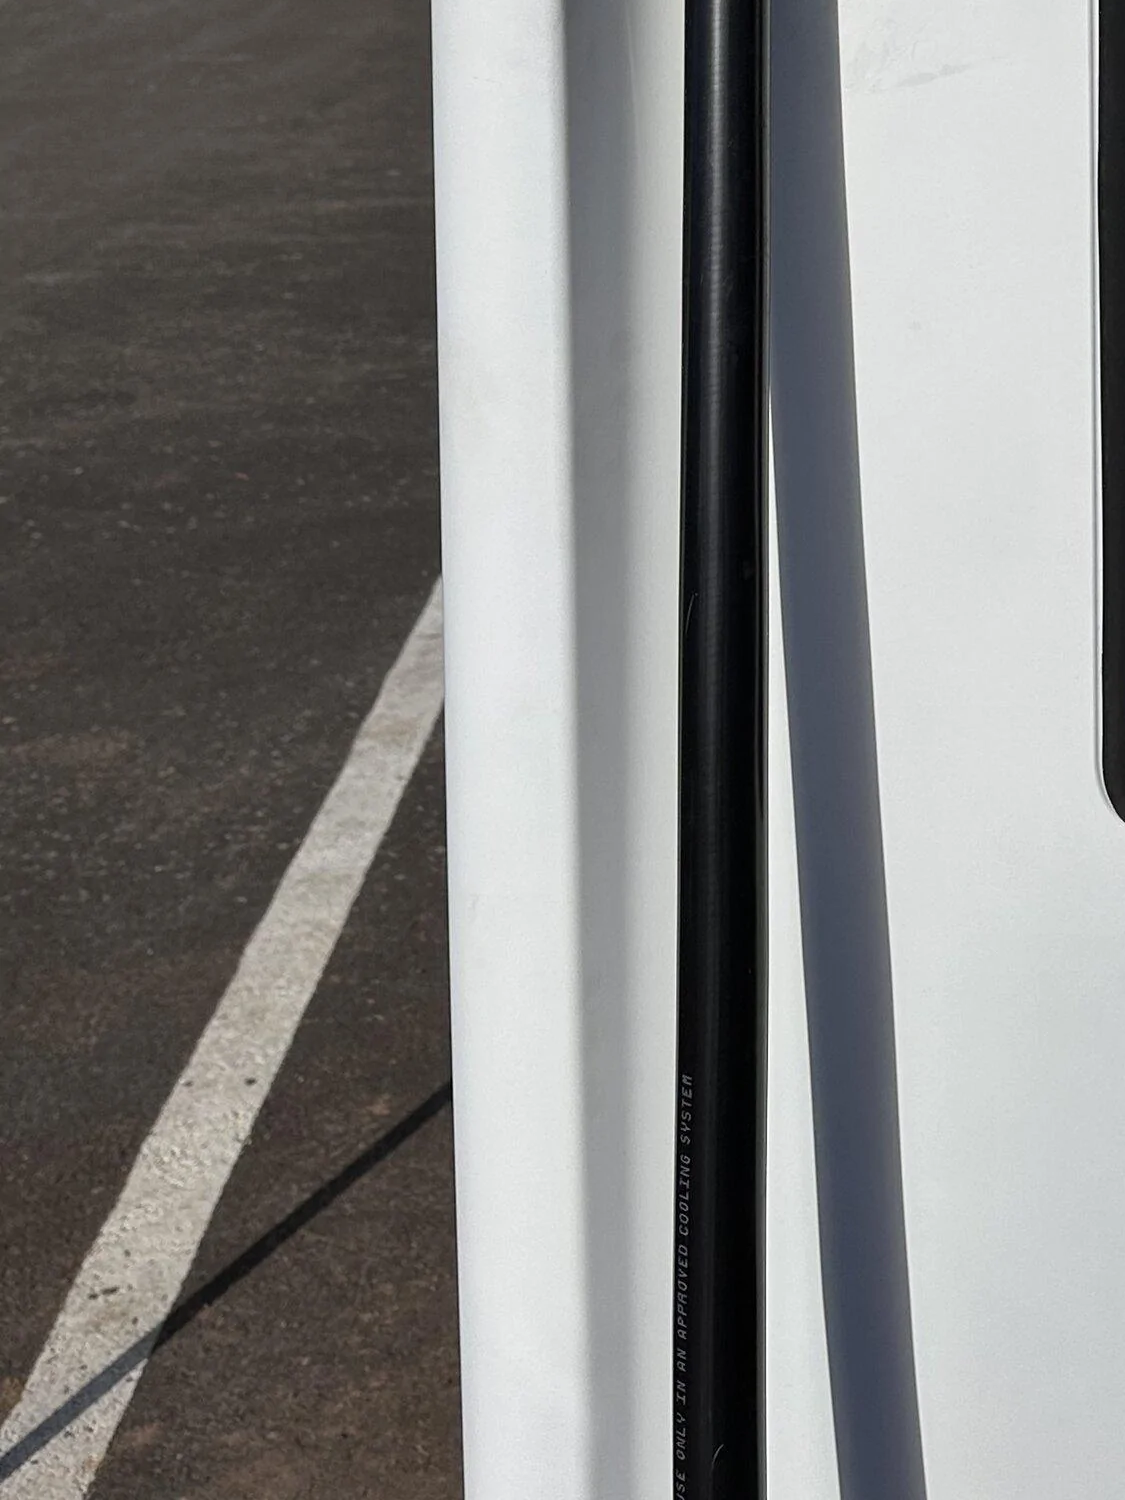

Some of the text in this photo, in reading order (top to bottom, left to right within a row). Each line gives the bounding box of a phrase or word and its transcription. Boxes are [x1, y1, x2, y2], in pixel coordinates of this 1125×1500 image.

[680, 1074, 693, 1146] SYSTEM
[678, 1154, 691, 1237] COOLING
[677, 1244, 688, 1340] APPROVED
[676, 1347, 687, 1372] AN
[676, 1379, 687, 1406] IN
[675, 1412, 687, 1461] ONLY
